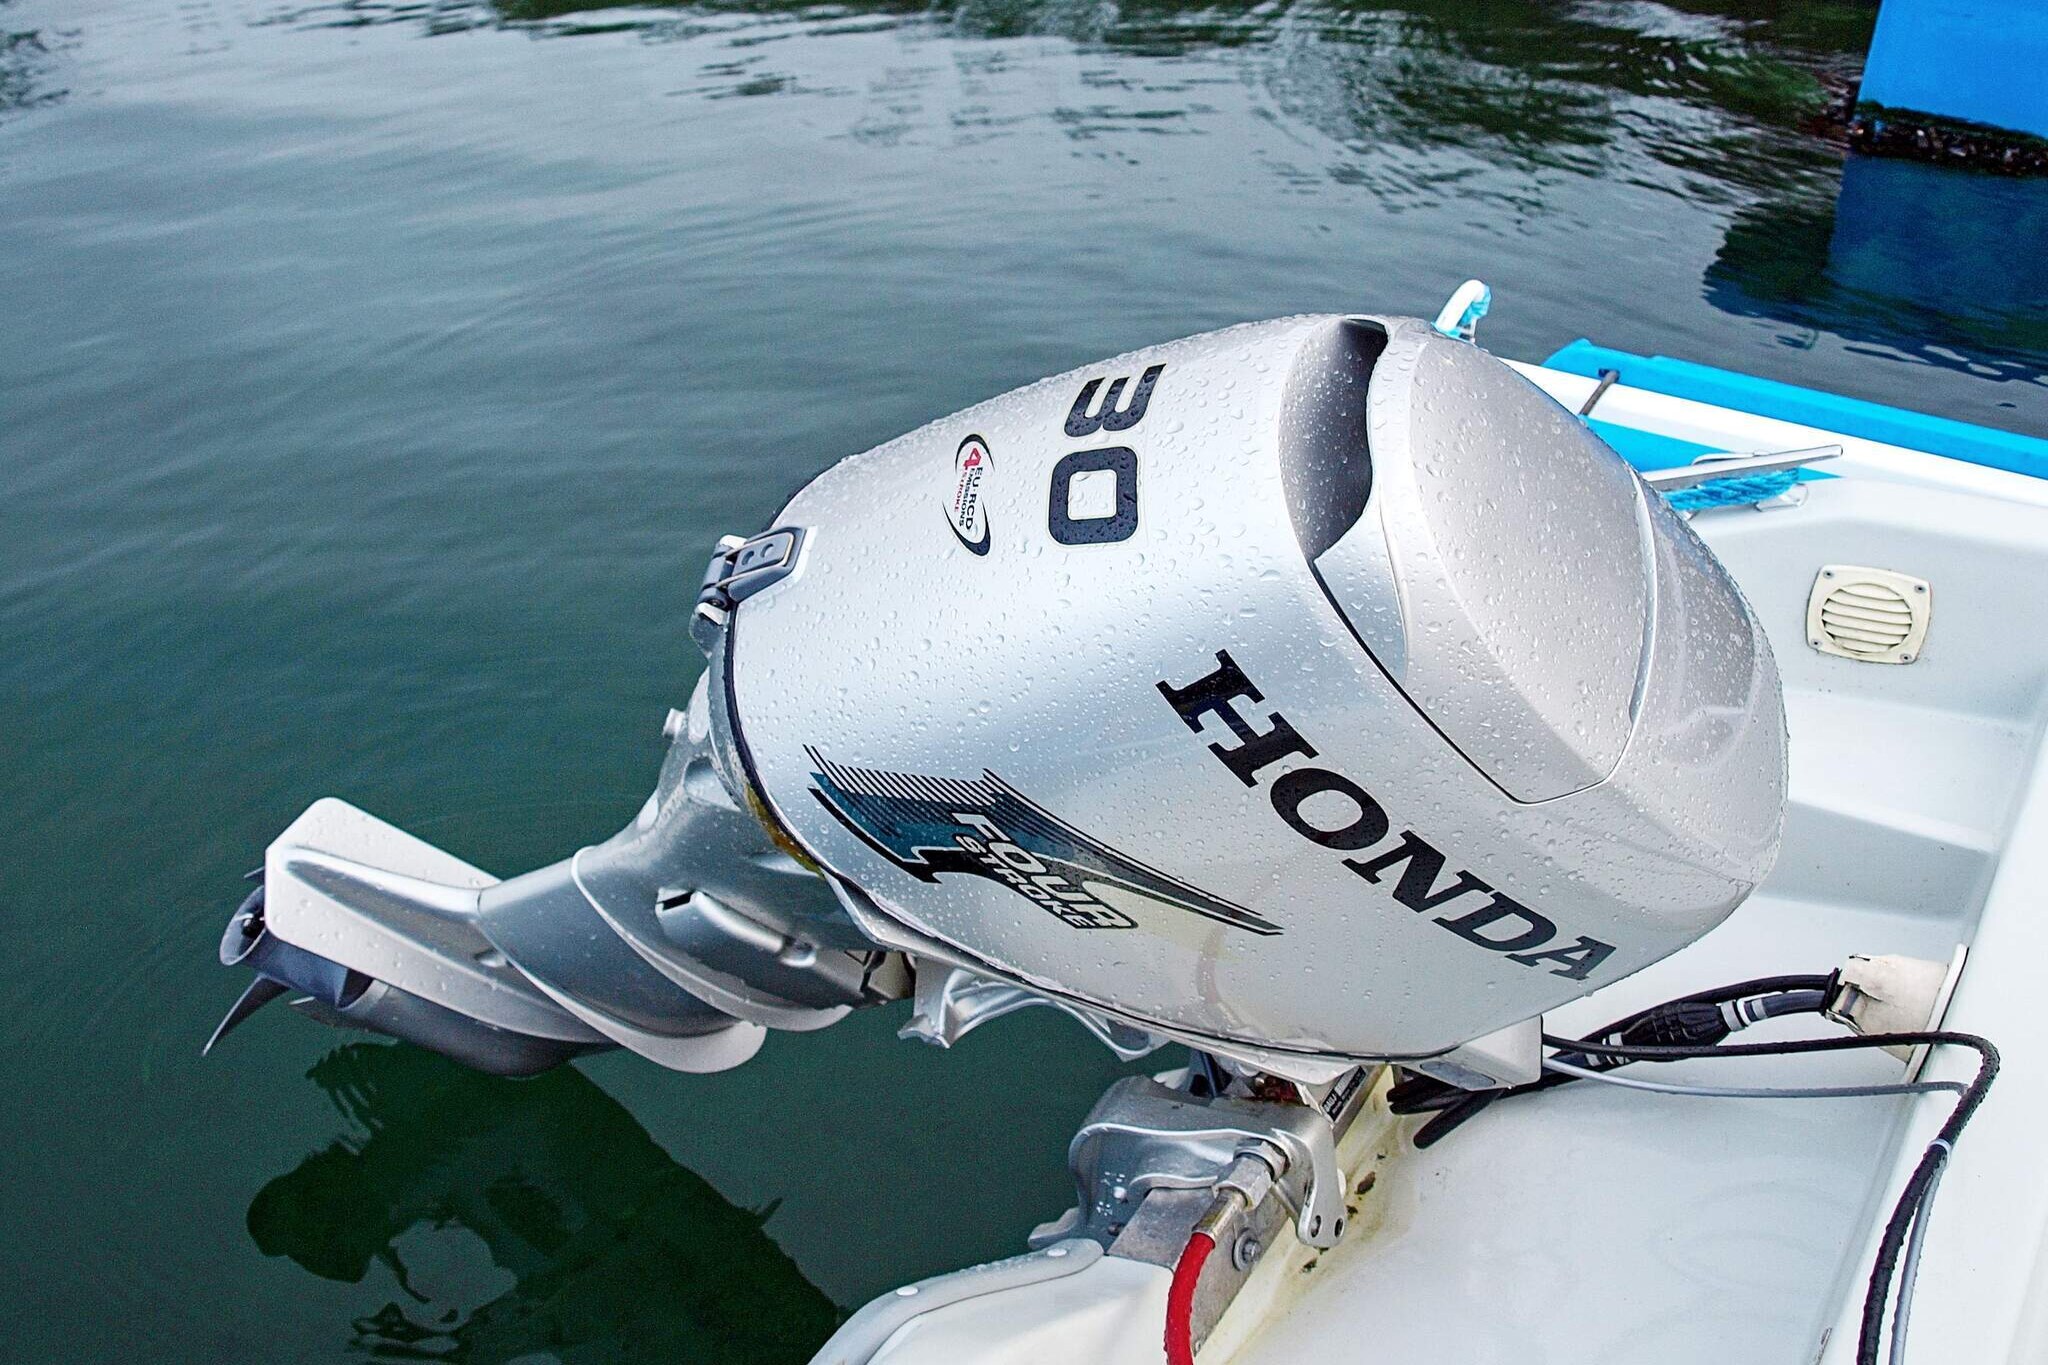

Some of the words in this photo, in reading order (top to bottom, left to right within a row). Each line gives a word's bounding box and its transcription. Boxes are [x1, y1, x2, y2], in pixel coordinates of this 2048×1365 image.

[959, 468, 976, 527] EMISSIONS
[963, 447, 981, 468] 4
[1048, 363, 1166, 545] 30
[1155, 648, 1617, 981] HONDA
[951, 812, 1135, 928] FOUR
[955, 835, 1097, 928] STROKE
